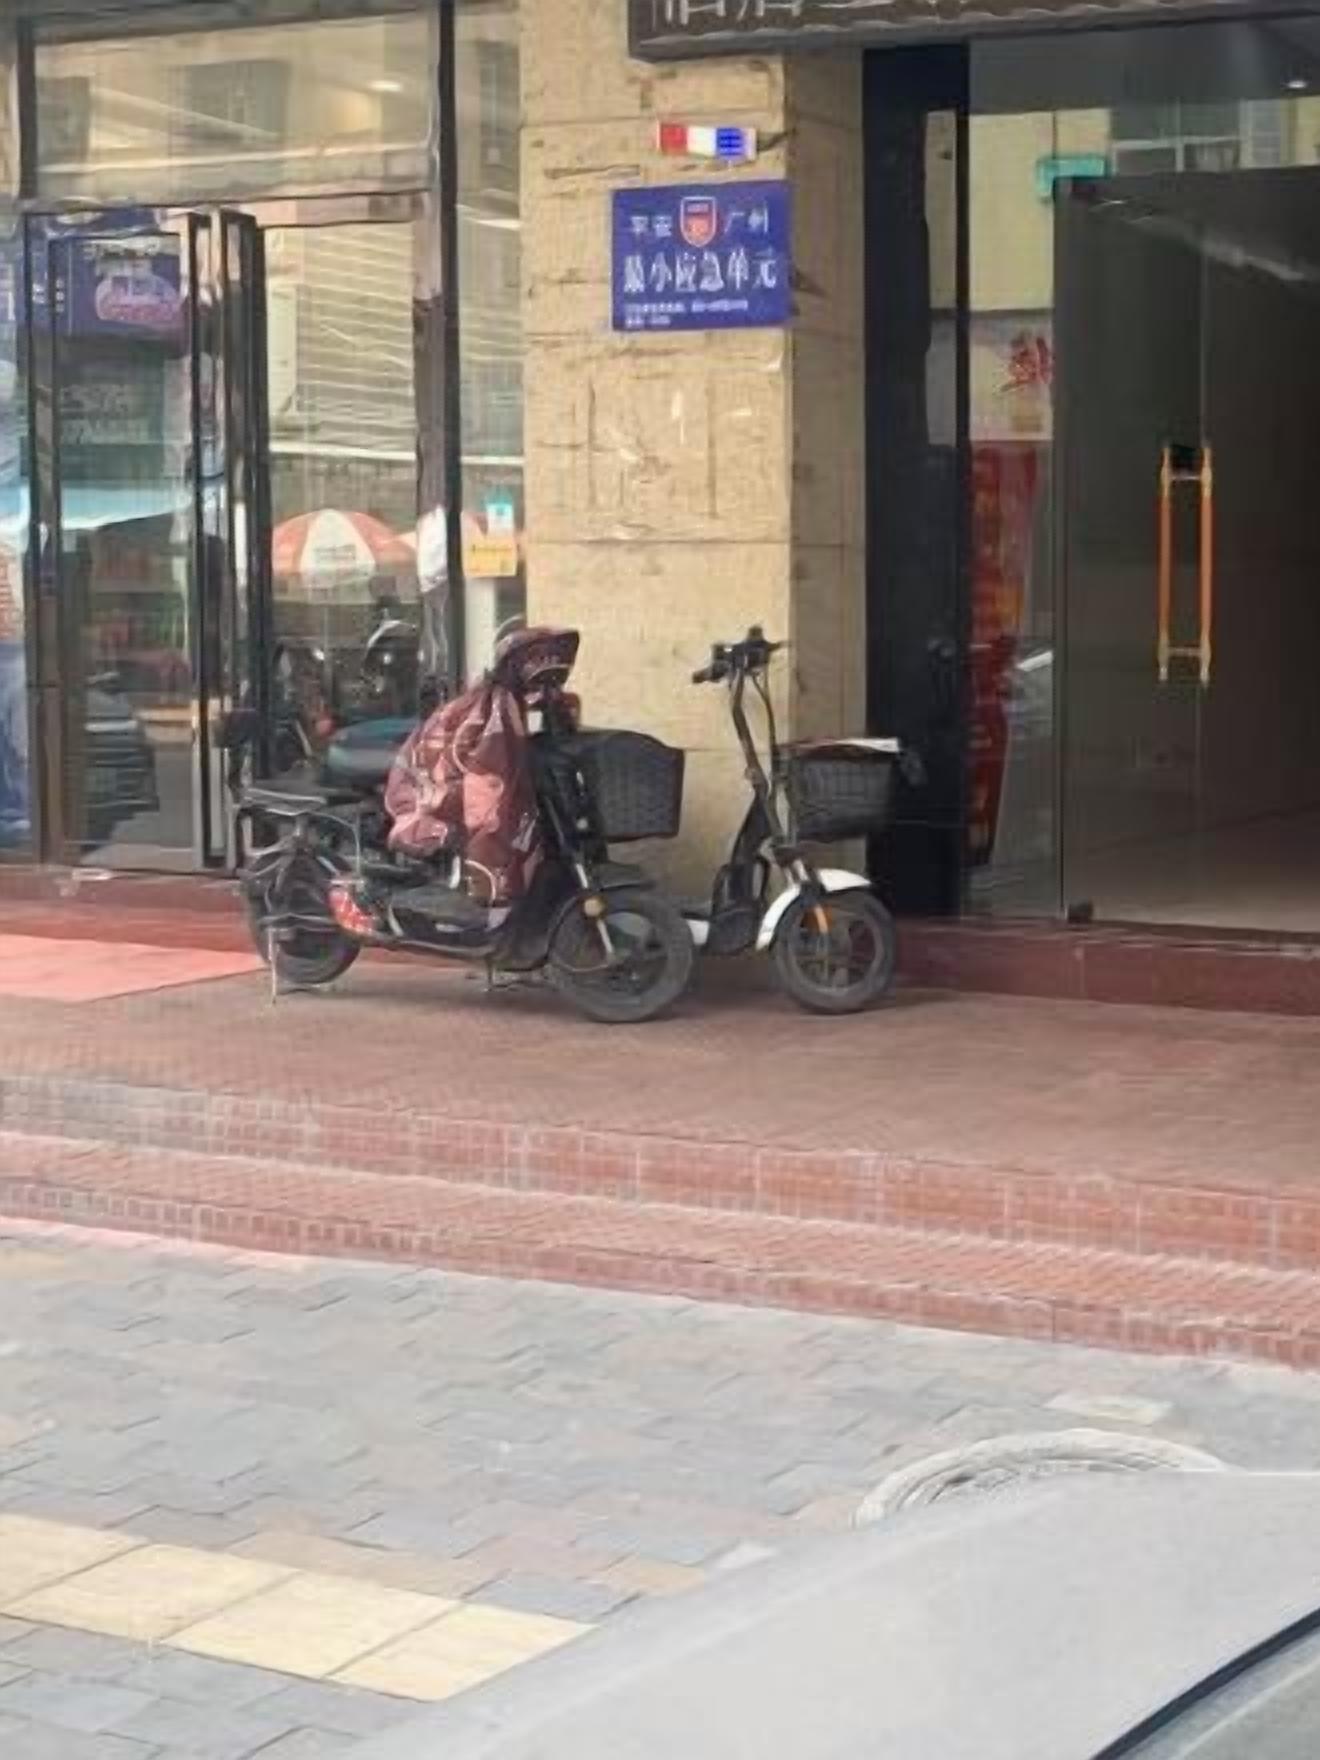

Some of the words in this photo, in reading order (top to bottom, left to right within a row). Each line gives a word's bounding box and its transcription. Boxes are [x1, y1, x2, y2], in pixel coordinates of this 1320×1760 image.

[623, 249, 777, 292] 最小应急单元
